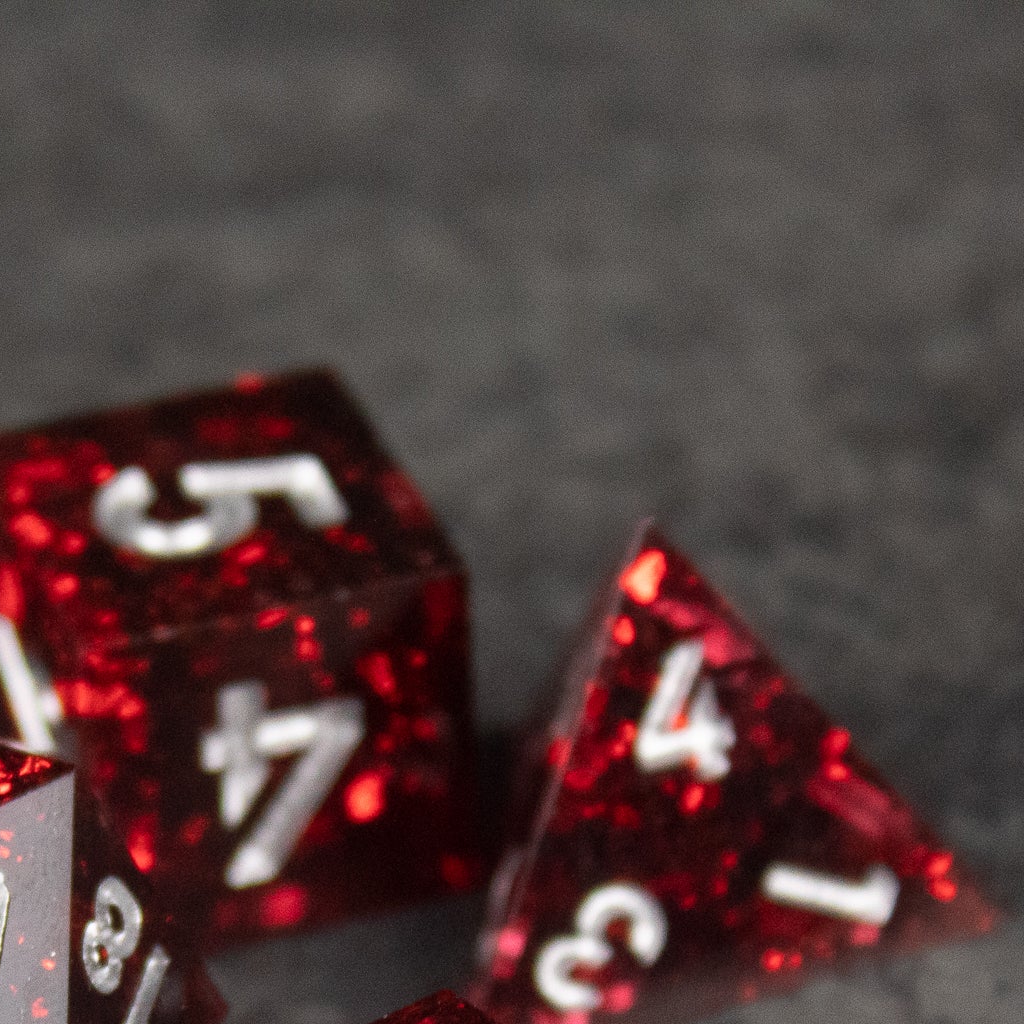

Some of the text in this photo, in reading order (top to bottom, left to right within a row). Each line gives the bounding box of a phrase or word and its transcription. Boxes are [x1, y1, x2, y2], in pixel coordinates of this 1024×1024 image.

[89, 453, 349, 555] 5
[635, 639, 737, 782] 4
[200, 682, 364, 890] 4
[533, 882, 667, 1013] 3
[761, 862, 900, 926] 1
